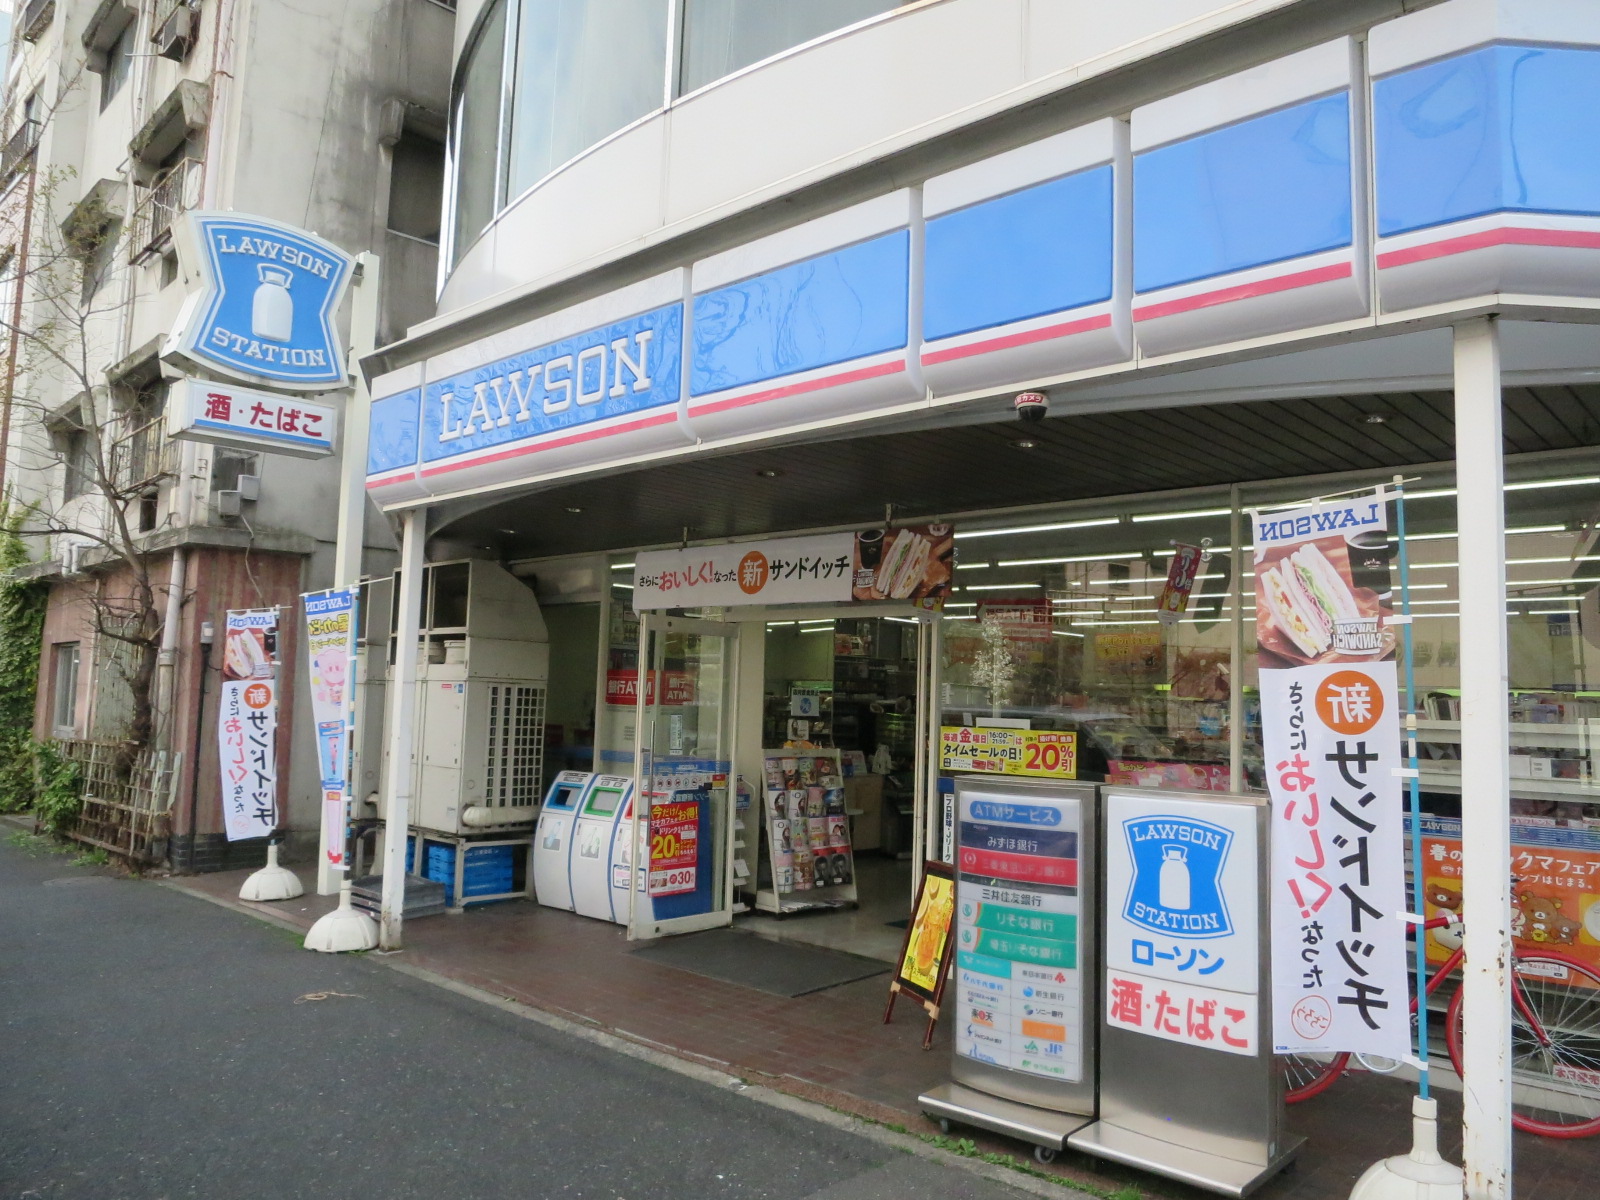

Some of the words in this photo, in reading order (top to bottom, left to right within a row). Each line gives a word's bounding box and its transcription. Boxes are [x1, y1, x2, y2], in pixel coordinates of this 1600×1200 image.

[217, 235, 332, 279] LAWSON
[211, 327, 326, 366] STATION
[439, 330, 653, 443] LAWSON
[205, 392, 322, 437] 酒・たばこ
[975, 804, 1055, 823] ATMサービス
[652, 835, 675, 859] 20
[987, 836, 1038, 853] みずほ銀行
[1132, 824, 1221, 850] LAWSON
[1510, 852, 1600, 874] クマフェア
[982, 888, 1042, 907] 三井住友銀行
[996, 911, 1054, 933] りそな銀行
[1133, 902, 1220, 930] STATION
[1132, 939, 1225, 975] ローソン
[1111, 977, 1248, 1048] 酒・たばこ
